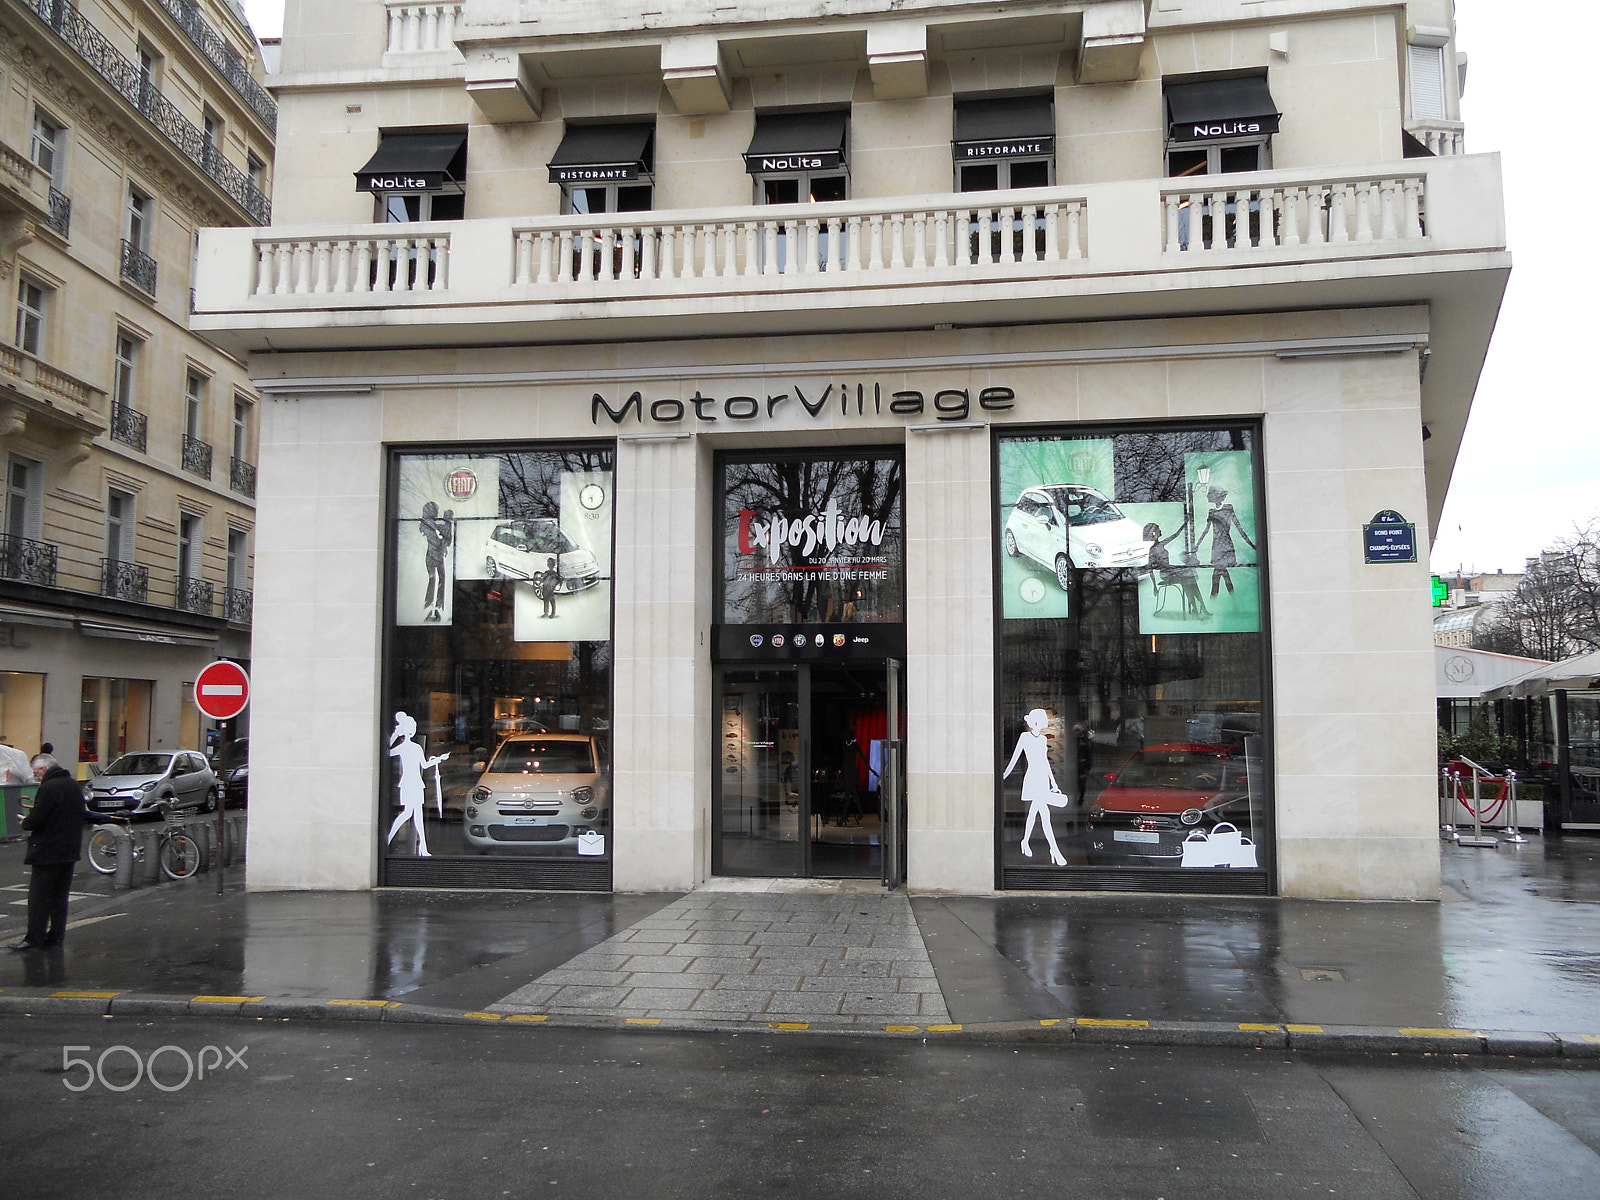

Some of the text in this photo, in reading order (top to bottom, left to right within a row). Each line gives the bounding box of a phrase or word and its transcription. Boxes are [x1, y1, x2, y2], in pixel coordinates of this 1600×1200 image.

[1193, 122, 1260, 137] NoLita
[967, 143, 1041, 156] RISTORANTE
[762, 156, 822, 170] NoLita
[560, 169, 628, 180] RISTORANTE
[371, 176, 426, 188] NoLita
[591, 382, 1015, 425] MotorVillage
[453, 477, 472, 493] FIAT
[583, 512, 600, 520] 8:30
[737, 498, 887, 565] Exposition
[808, 557, 818, 565] DU
[818, 557, 827, 565] 20
[852, 556, 861, 564] AU
[862, 556, 871, 564] 20
[871, 556, 887, 564] MARS
[737, 571, 887, 582] 24 HEURES DANS LA VIE D'UNE FEMME
[137, 633, 177, 645] LANCEL
[853, 636, 870, 644] Jeep
